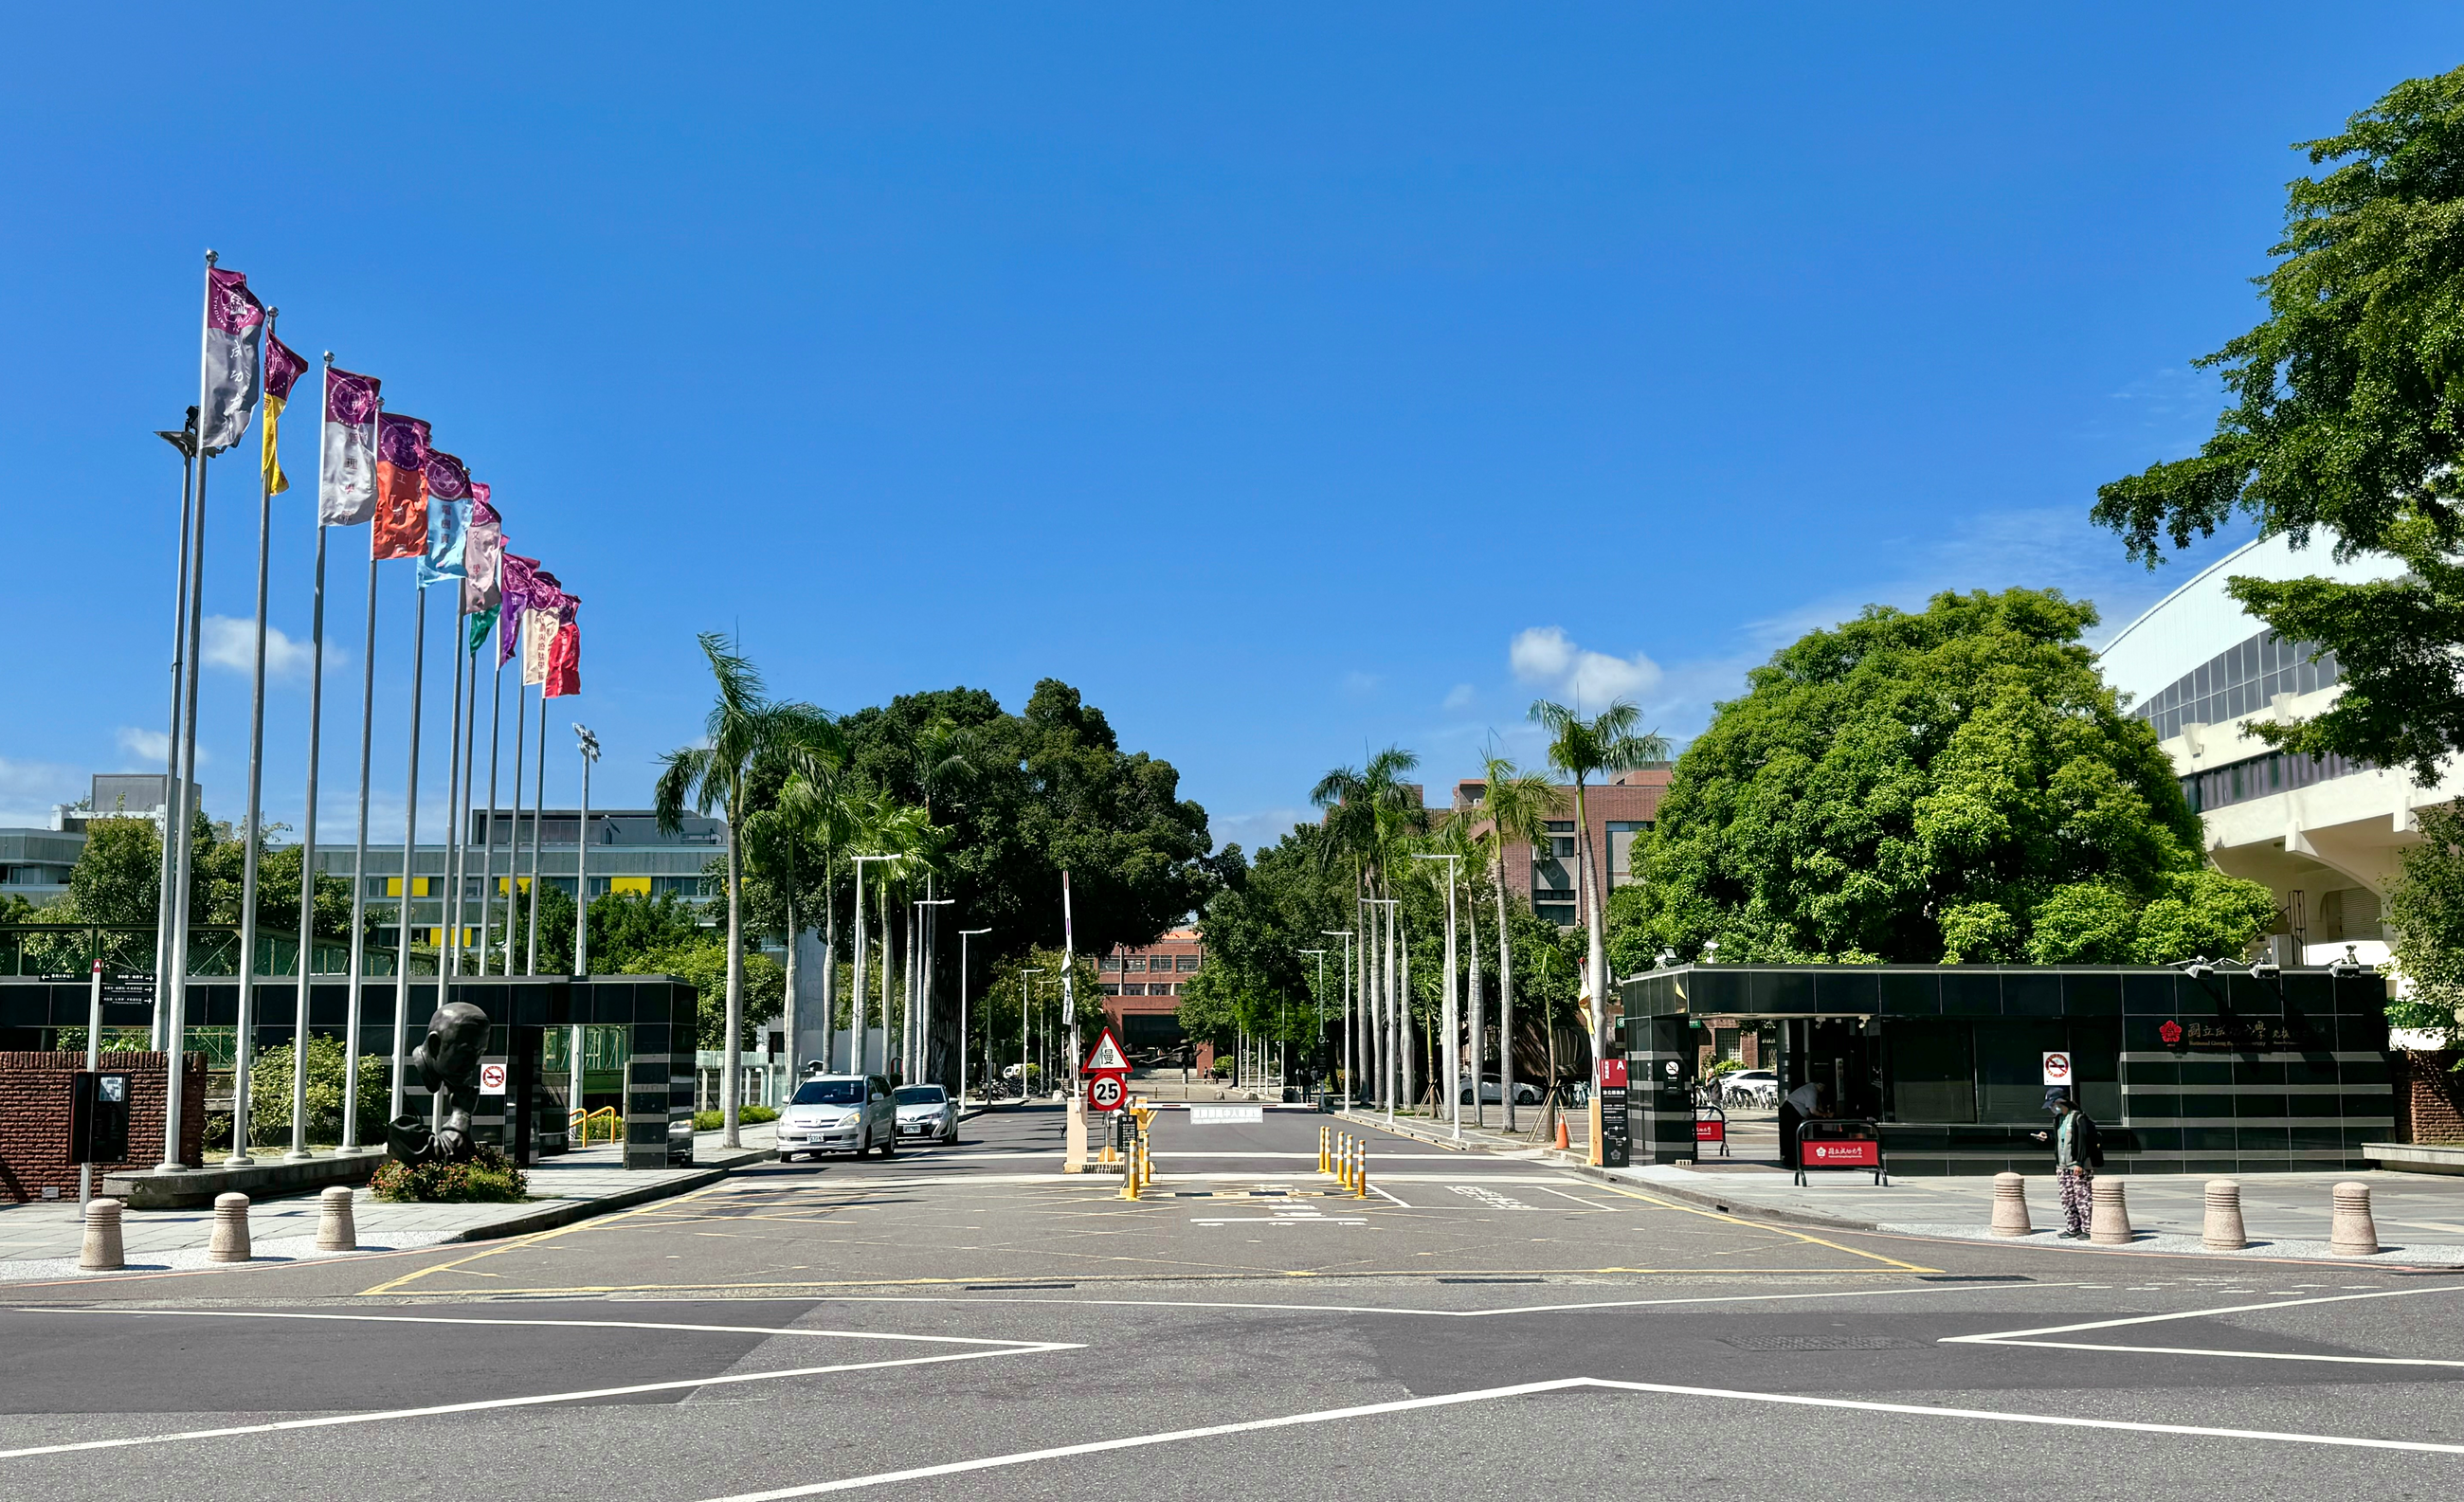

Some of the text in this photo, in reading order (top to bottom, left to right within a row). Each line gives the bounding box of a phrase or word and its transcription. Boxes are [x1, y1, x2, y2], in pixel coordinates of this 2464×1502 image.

[1101, 1049, 1114, 1065] 慢
[1617, 1060, 1624, 1070] A
[1096, 1083, 1118, 1100] 25
